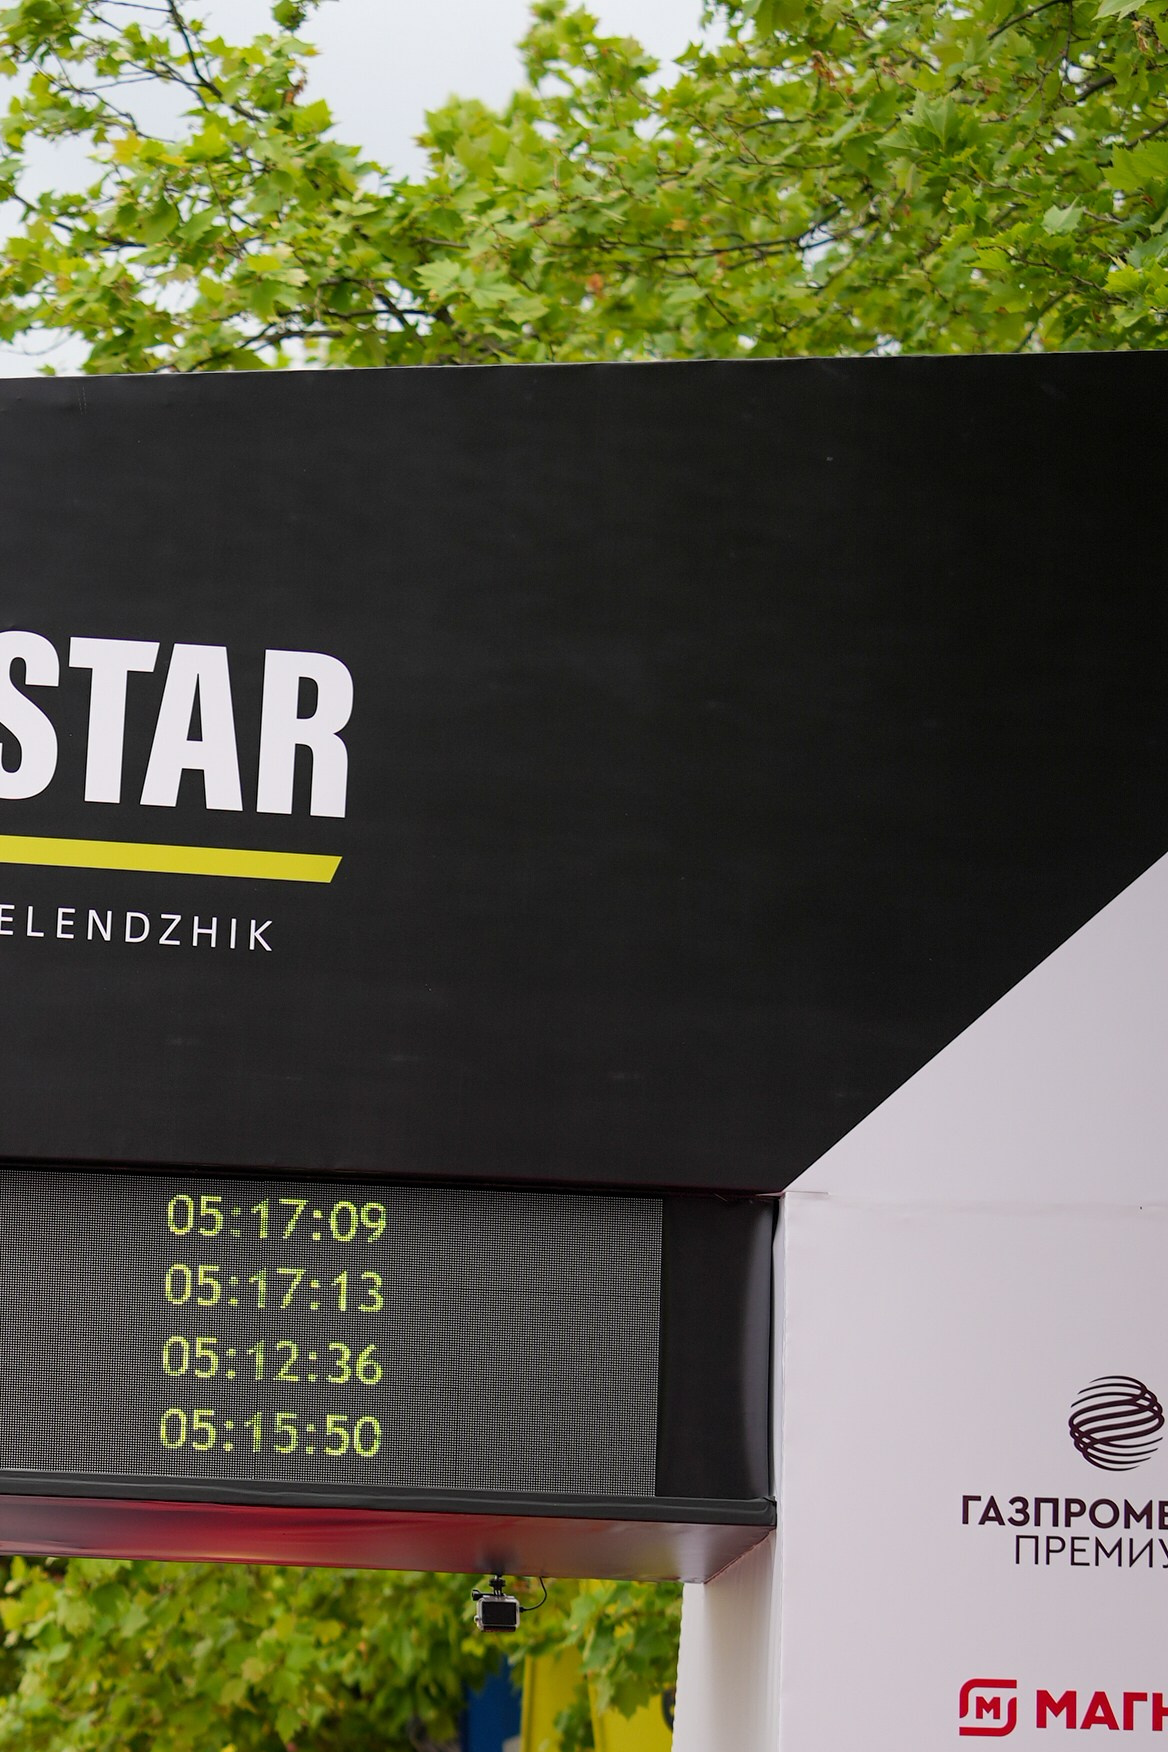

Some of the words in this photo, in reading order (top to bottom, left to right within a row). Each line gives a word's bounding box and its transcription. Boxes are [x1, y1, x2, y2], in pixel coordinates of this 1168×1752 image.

[168, 1194, 386, 1242] 05:17:09
[165, 1264, 384, 1312] 05:17:13
[163, 1336, 383, 1385] 05:12:36
[160, 1408, 381, 1456] 05:15:50
